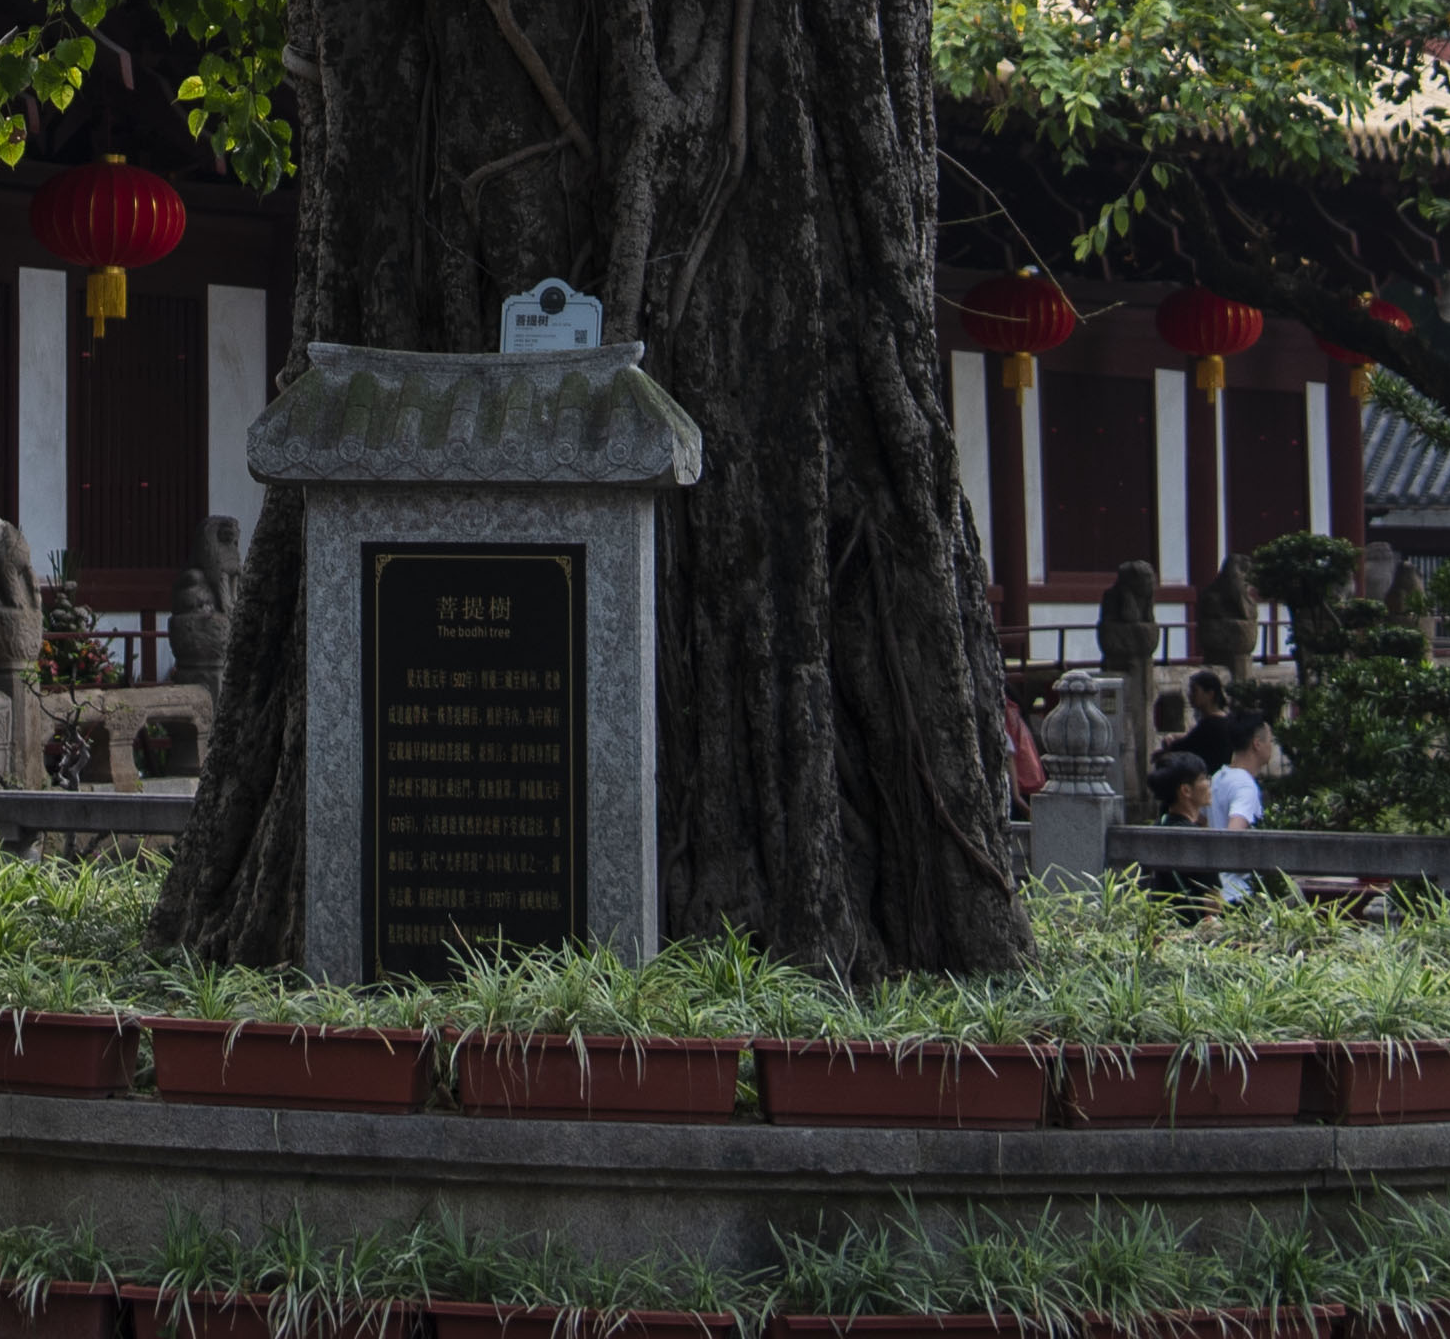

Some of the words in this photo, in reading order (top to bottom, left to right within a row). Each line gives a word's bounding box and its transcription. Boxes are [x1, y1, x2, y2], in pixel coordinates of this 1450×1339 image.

[436, 594, 512, 621] 菩提樹
[437, 625, 456, 638] The
[458, 625, 488, 638] bodhi
[490, 626, 511, 638] tree
